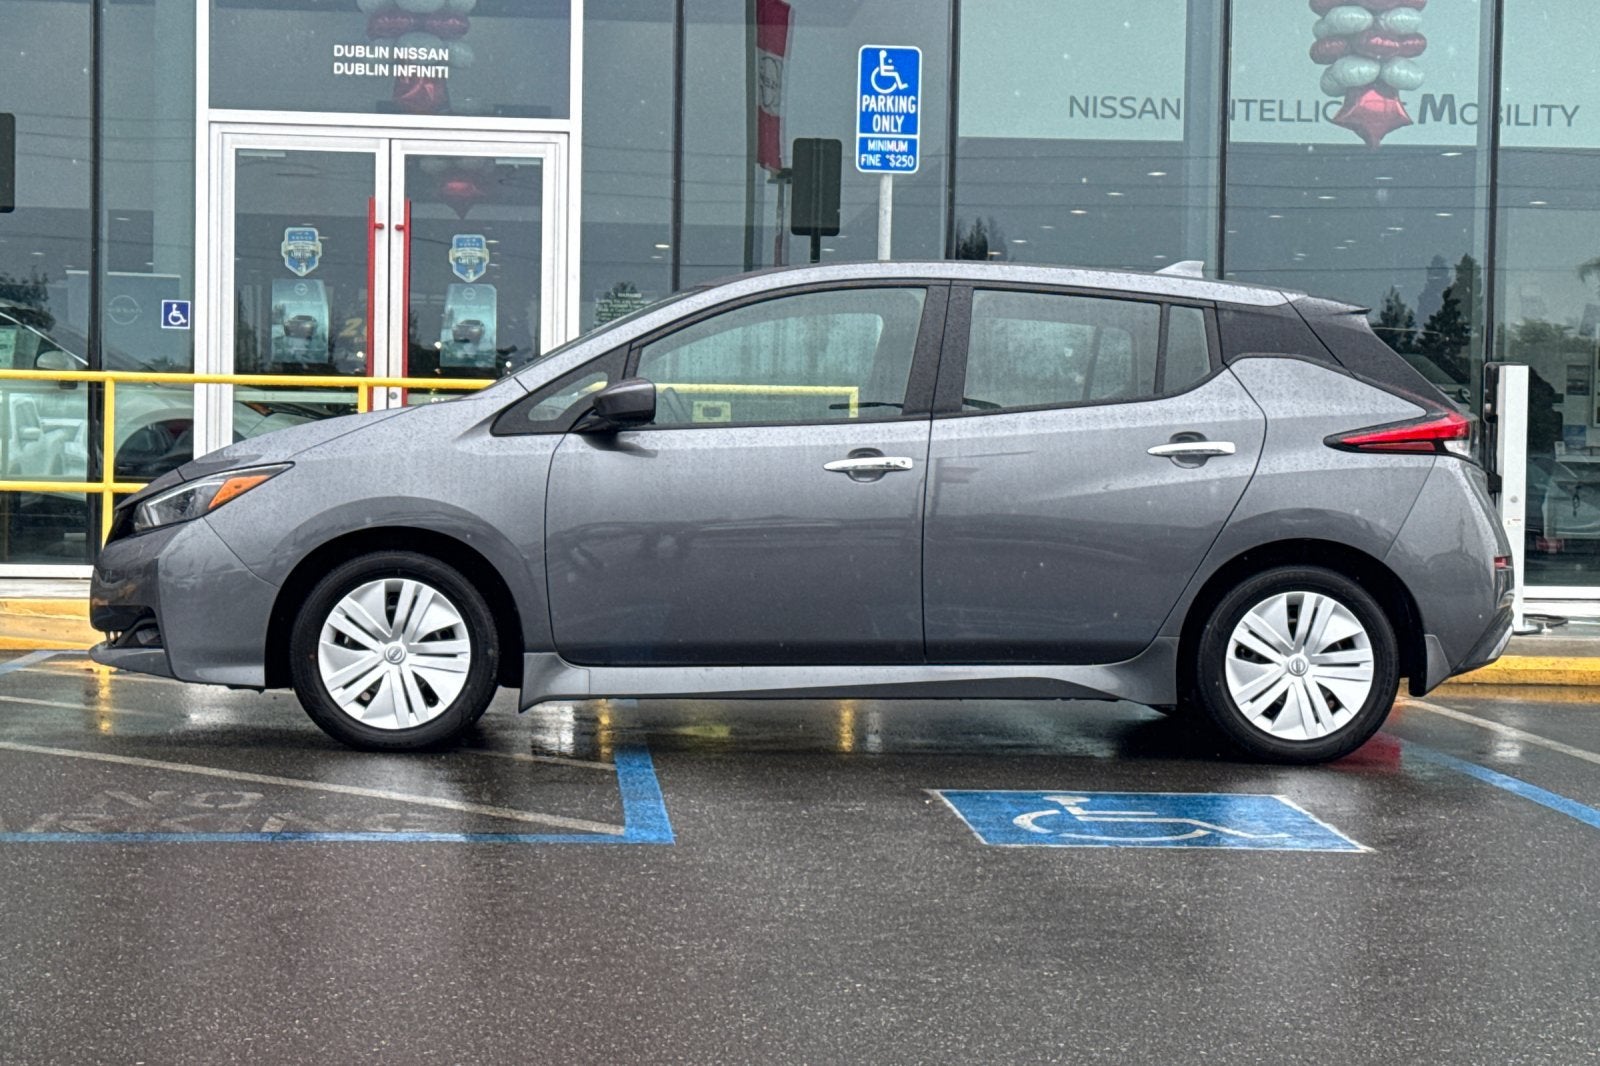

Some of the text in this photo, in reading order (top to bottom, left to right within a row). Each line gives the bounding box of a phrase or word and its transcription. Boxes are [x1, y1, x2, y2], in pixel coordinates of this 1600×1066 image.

[333, 44, 449, 61] DUBLIN NISSAN
[333, 61, 449, 79] DUBLIN INFINITI
[862, 94, 917, 114] PARKING
[1069, 95, 1181, 120] NISSAN
[1418, 93, 1580, 128] MOILITY
[872, 113, 905, 133] ONLY
[867, 139, 908, 153] MINIMUM
[861, 153, 882, 167] FINE
